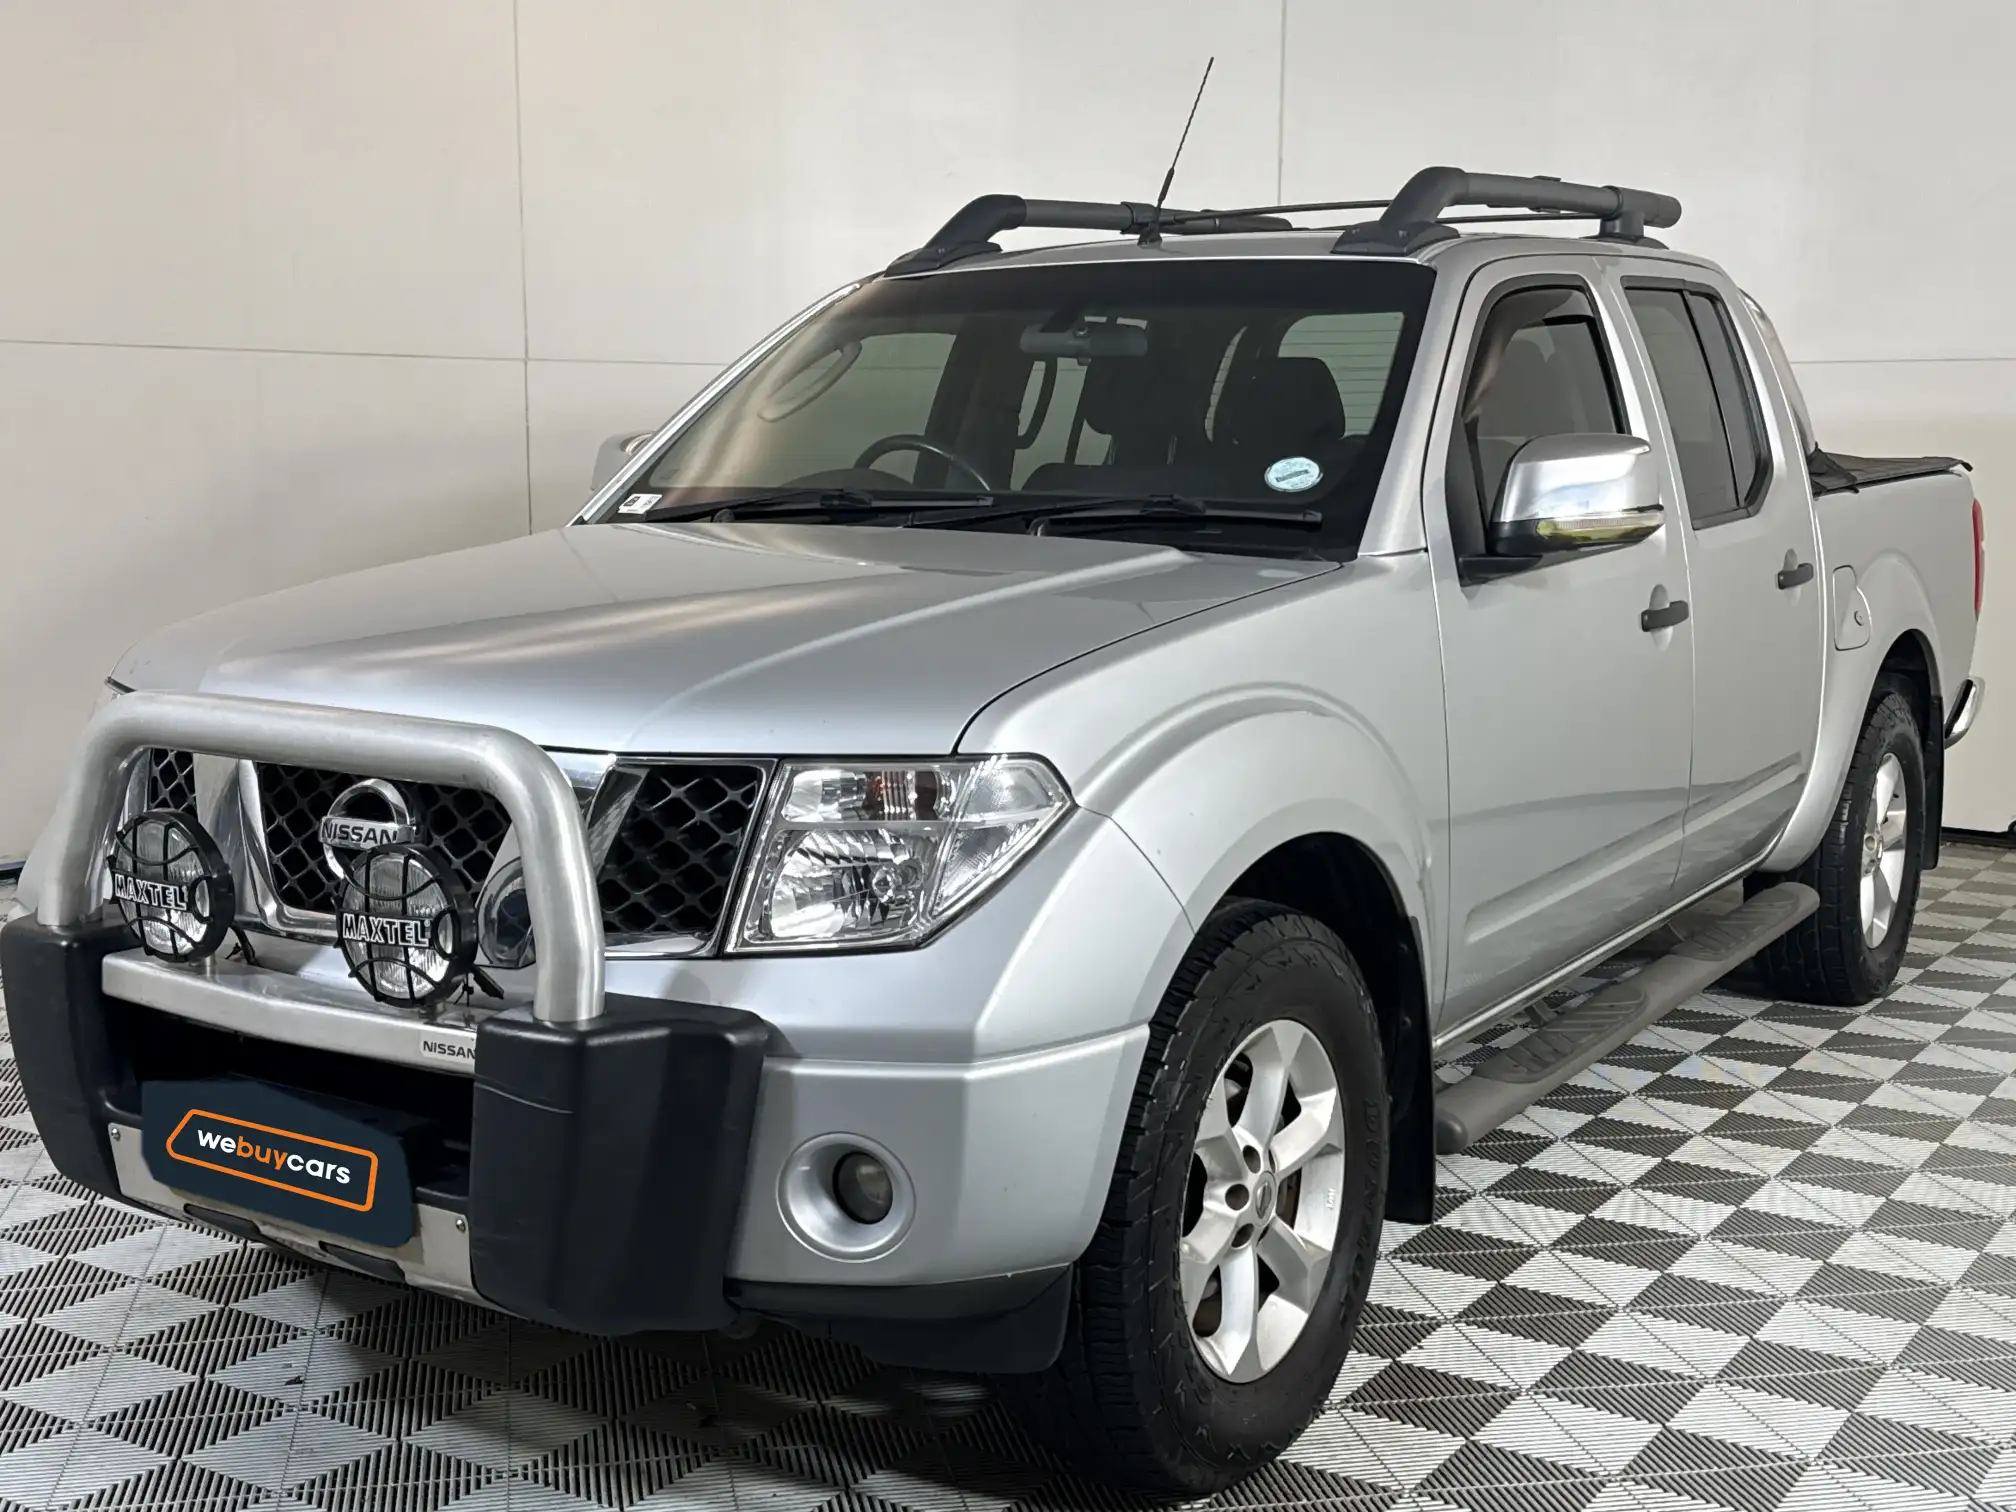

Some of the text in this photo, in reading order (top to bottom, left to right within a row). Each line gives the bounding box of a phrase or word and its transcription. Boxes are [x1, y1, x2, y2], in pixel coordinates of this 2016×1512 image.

[321, 821, 398, 845] NISSAN
[114, 873, 187, 911] MAXTEL
[342, 913, 429, 947] MAXTEL
[423, 1040, 476, 1060] NISSAN
